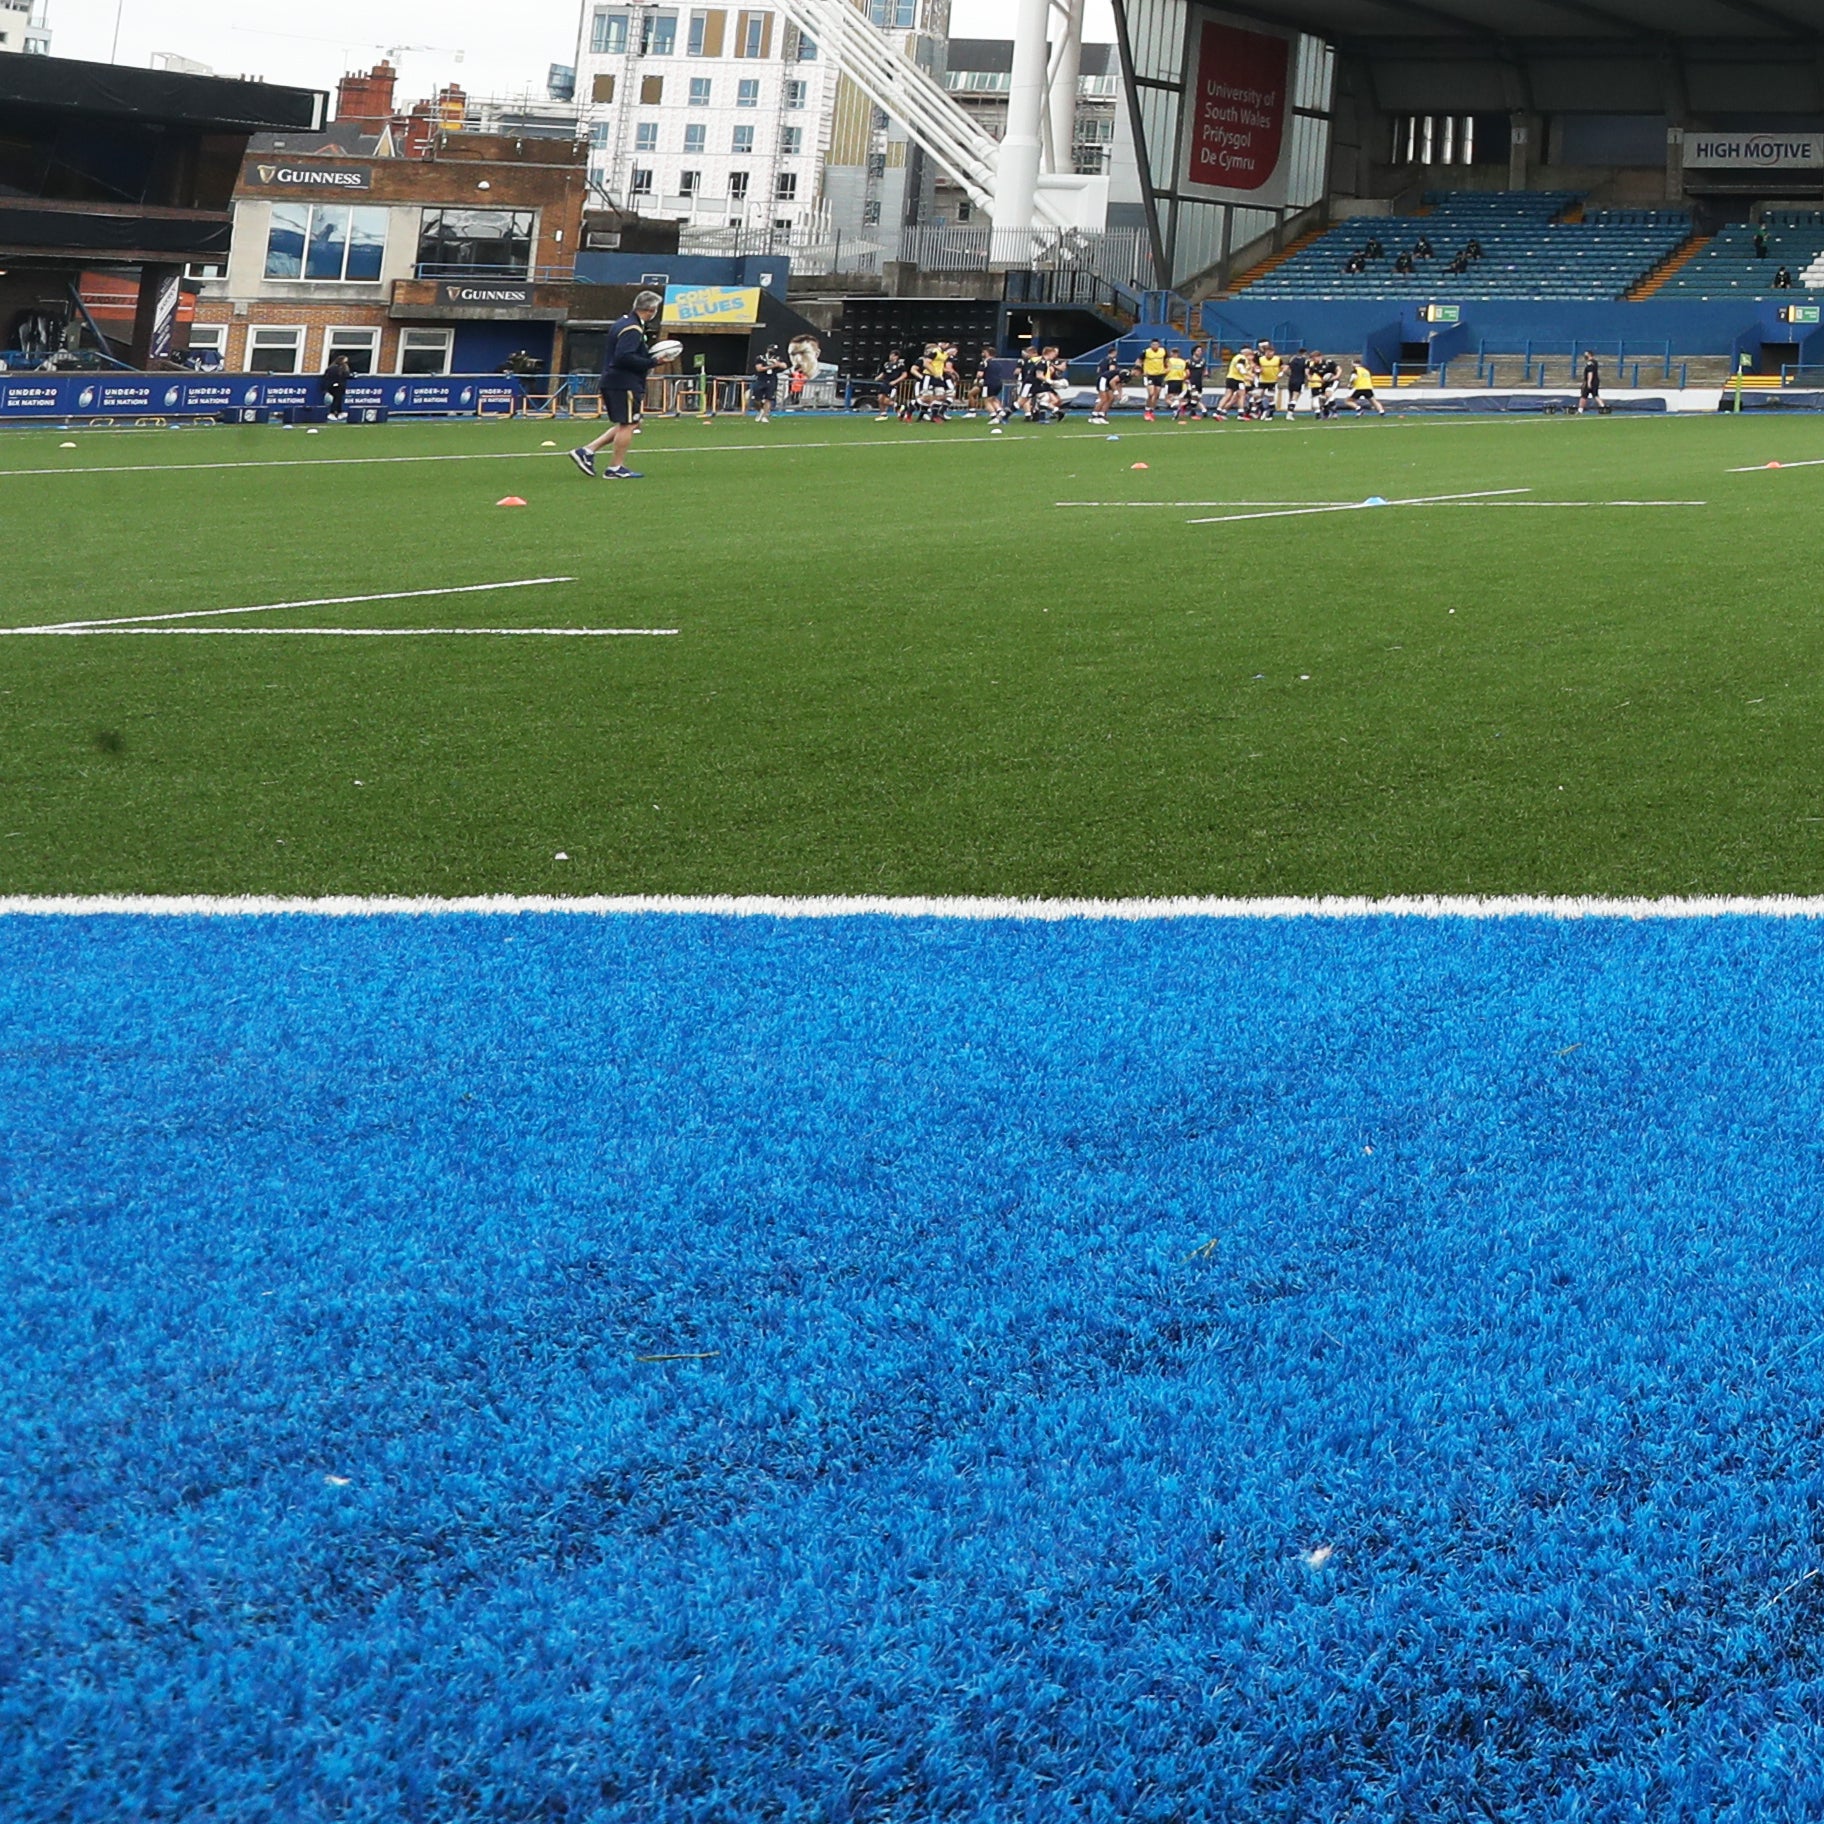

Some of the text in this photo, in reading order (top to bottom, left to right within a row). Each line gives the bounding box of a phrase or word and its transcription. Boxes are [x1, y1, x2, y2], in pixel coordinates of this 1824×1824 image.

[1207, 80, 1276, 108] University of
[1204, 102, 1272, 128] South Wales
[1202, 124, 1251, 150] Prifysgol
[1200, 147, 1256, 172] De Cymru
[1696, 143, 1811, 159] HIGH MOTIVE
[277, 167, 362, 186] GUINNESS
[461, 288, 526, 301] GUINNESS
[679, 297, 745, 320] BLUES
[9, 389, 57, 397] UNDER-20
[105, 388, 150, 397] UNDER-20
